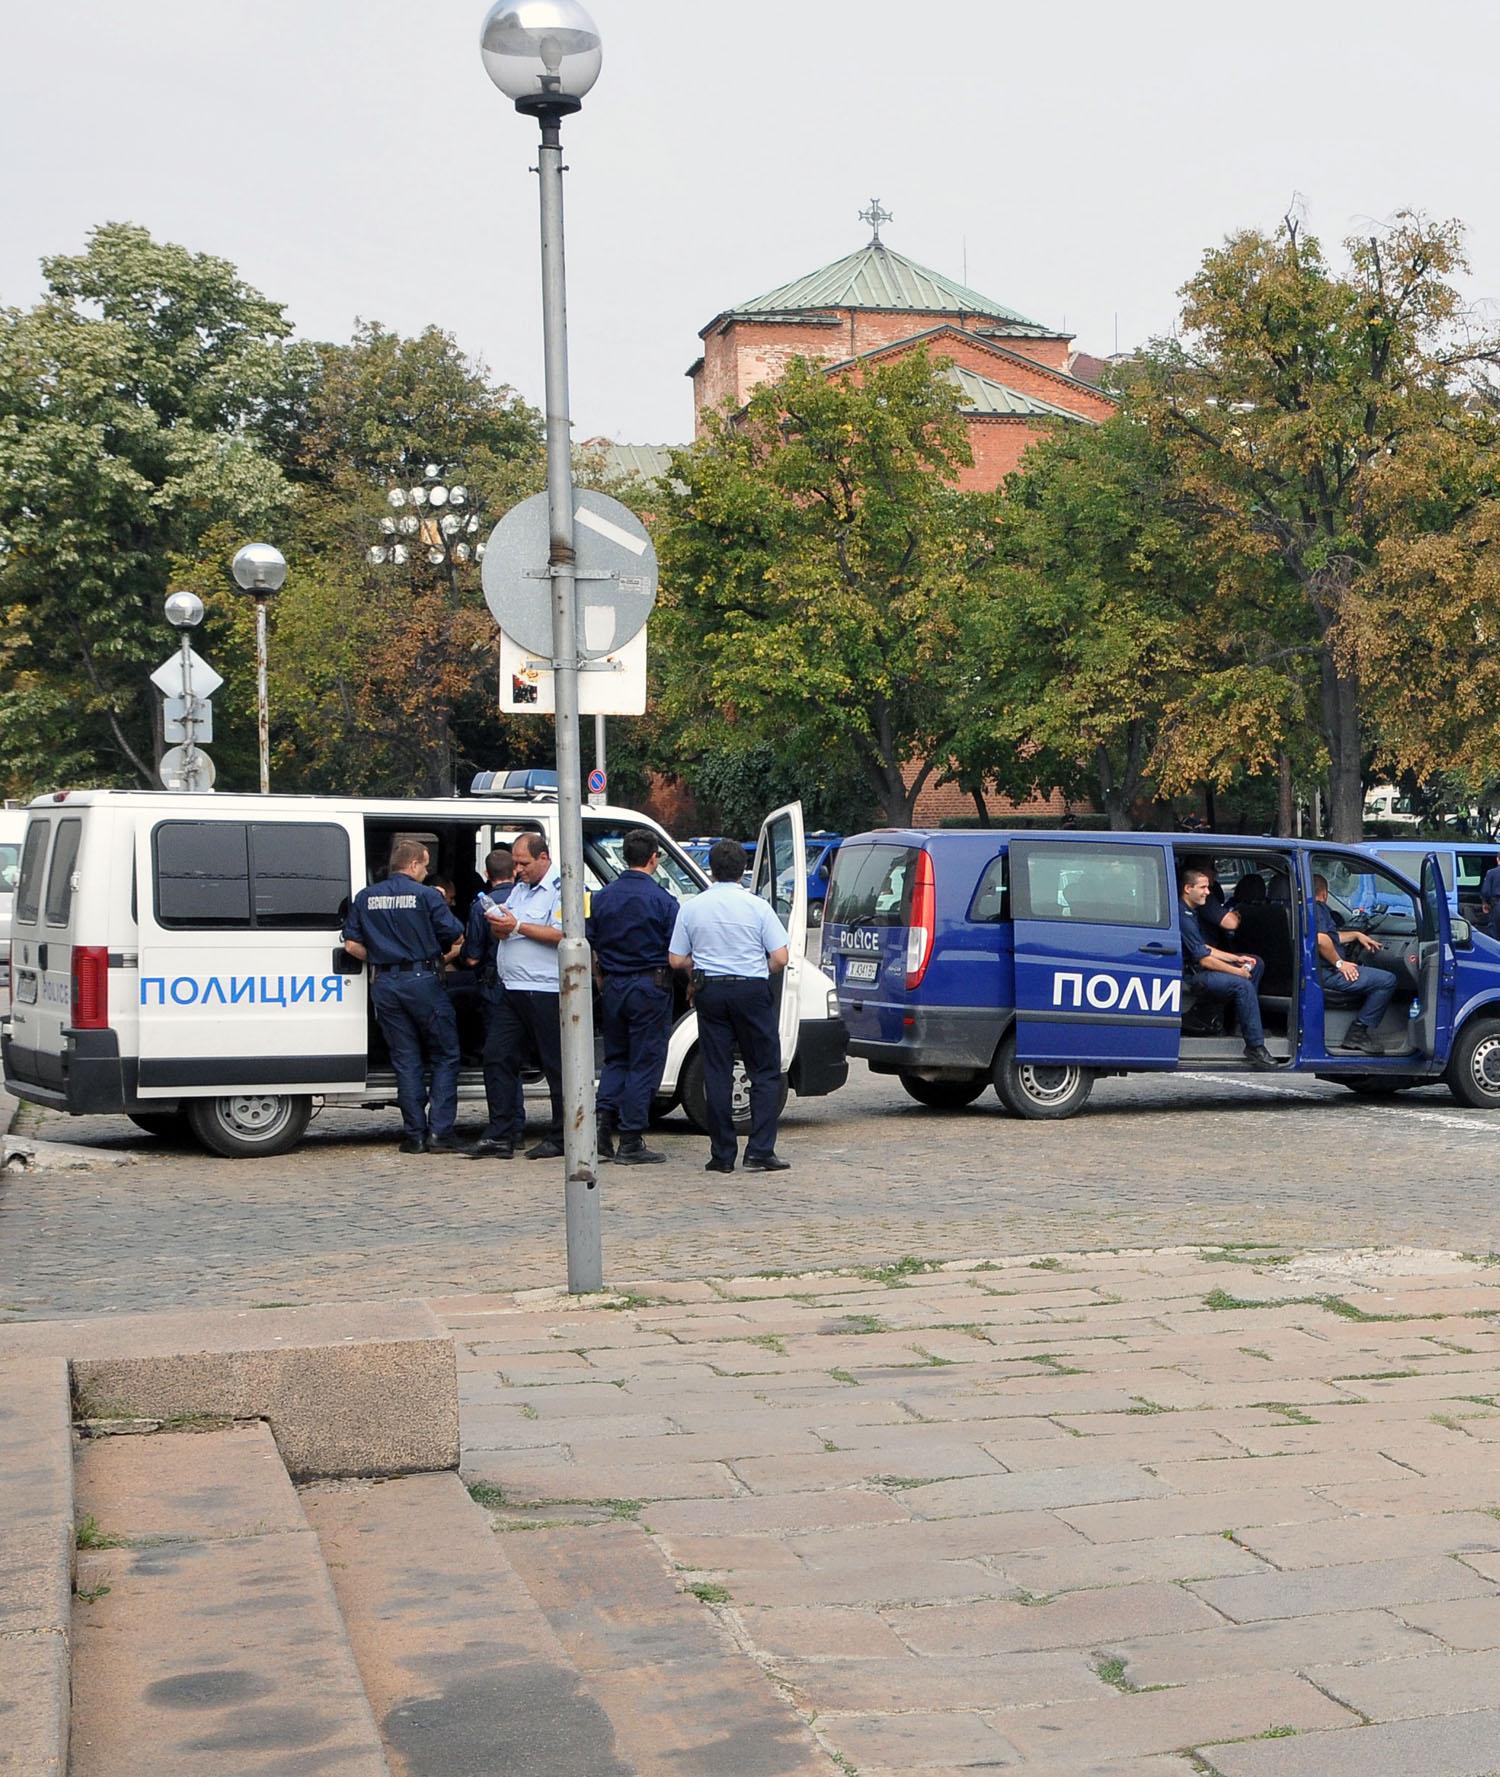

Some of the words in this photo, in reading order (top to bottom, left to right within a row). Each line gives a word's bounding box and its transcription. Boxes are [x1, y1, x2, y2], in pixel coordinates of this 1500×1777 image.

[395, 895, 417, 909] POLICE
[840, 931, 880, 951] POLICE
[43, 981, 69, 1005] POLICE
[140, 975, 344, 1007] ПОЛИЦИЯ
[1052, 972, 1182, 1012] ПОЛИ
